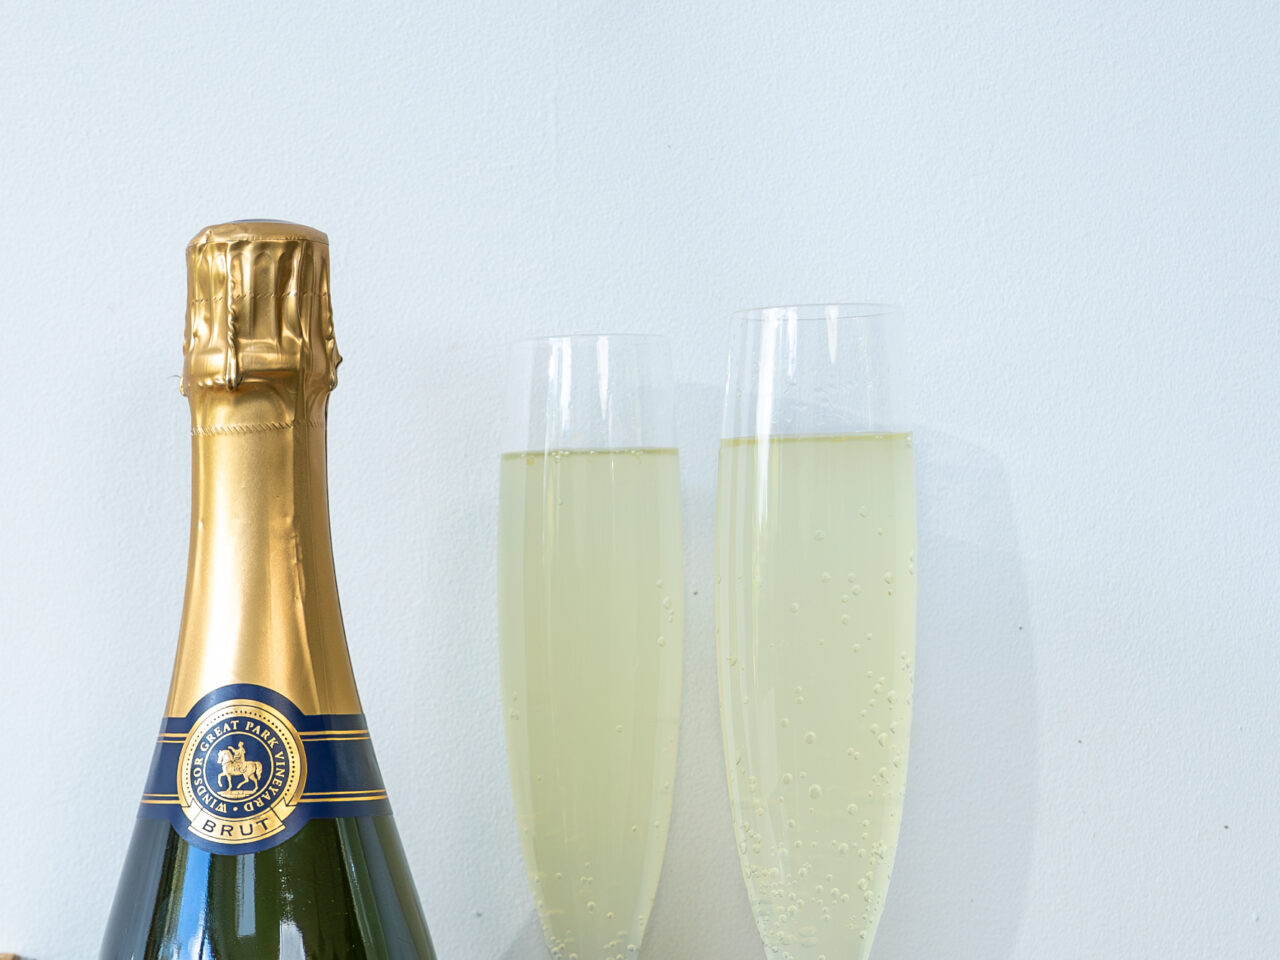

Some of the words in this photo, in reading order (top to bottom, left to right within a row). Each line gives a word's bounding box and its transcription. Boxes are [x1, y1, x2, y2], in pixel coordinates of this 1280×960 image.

[200, 720, 239, 752] GREAT
[245, 721, 279, 749] PARK
[193, 757, 228, 814] WINDSOR
[243, 751, 286, 812] VINEYARD
[202, 818, 270, 837] BRUT
